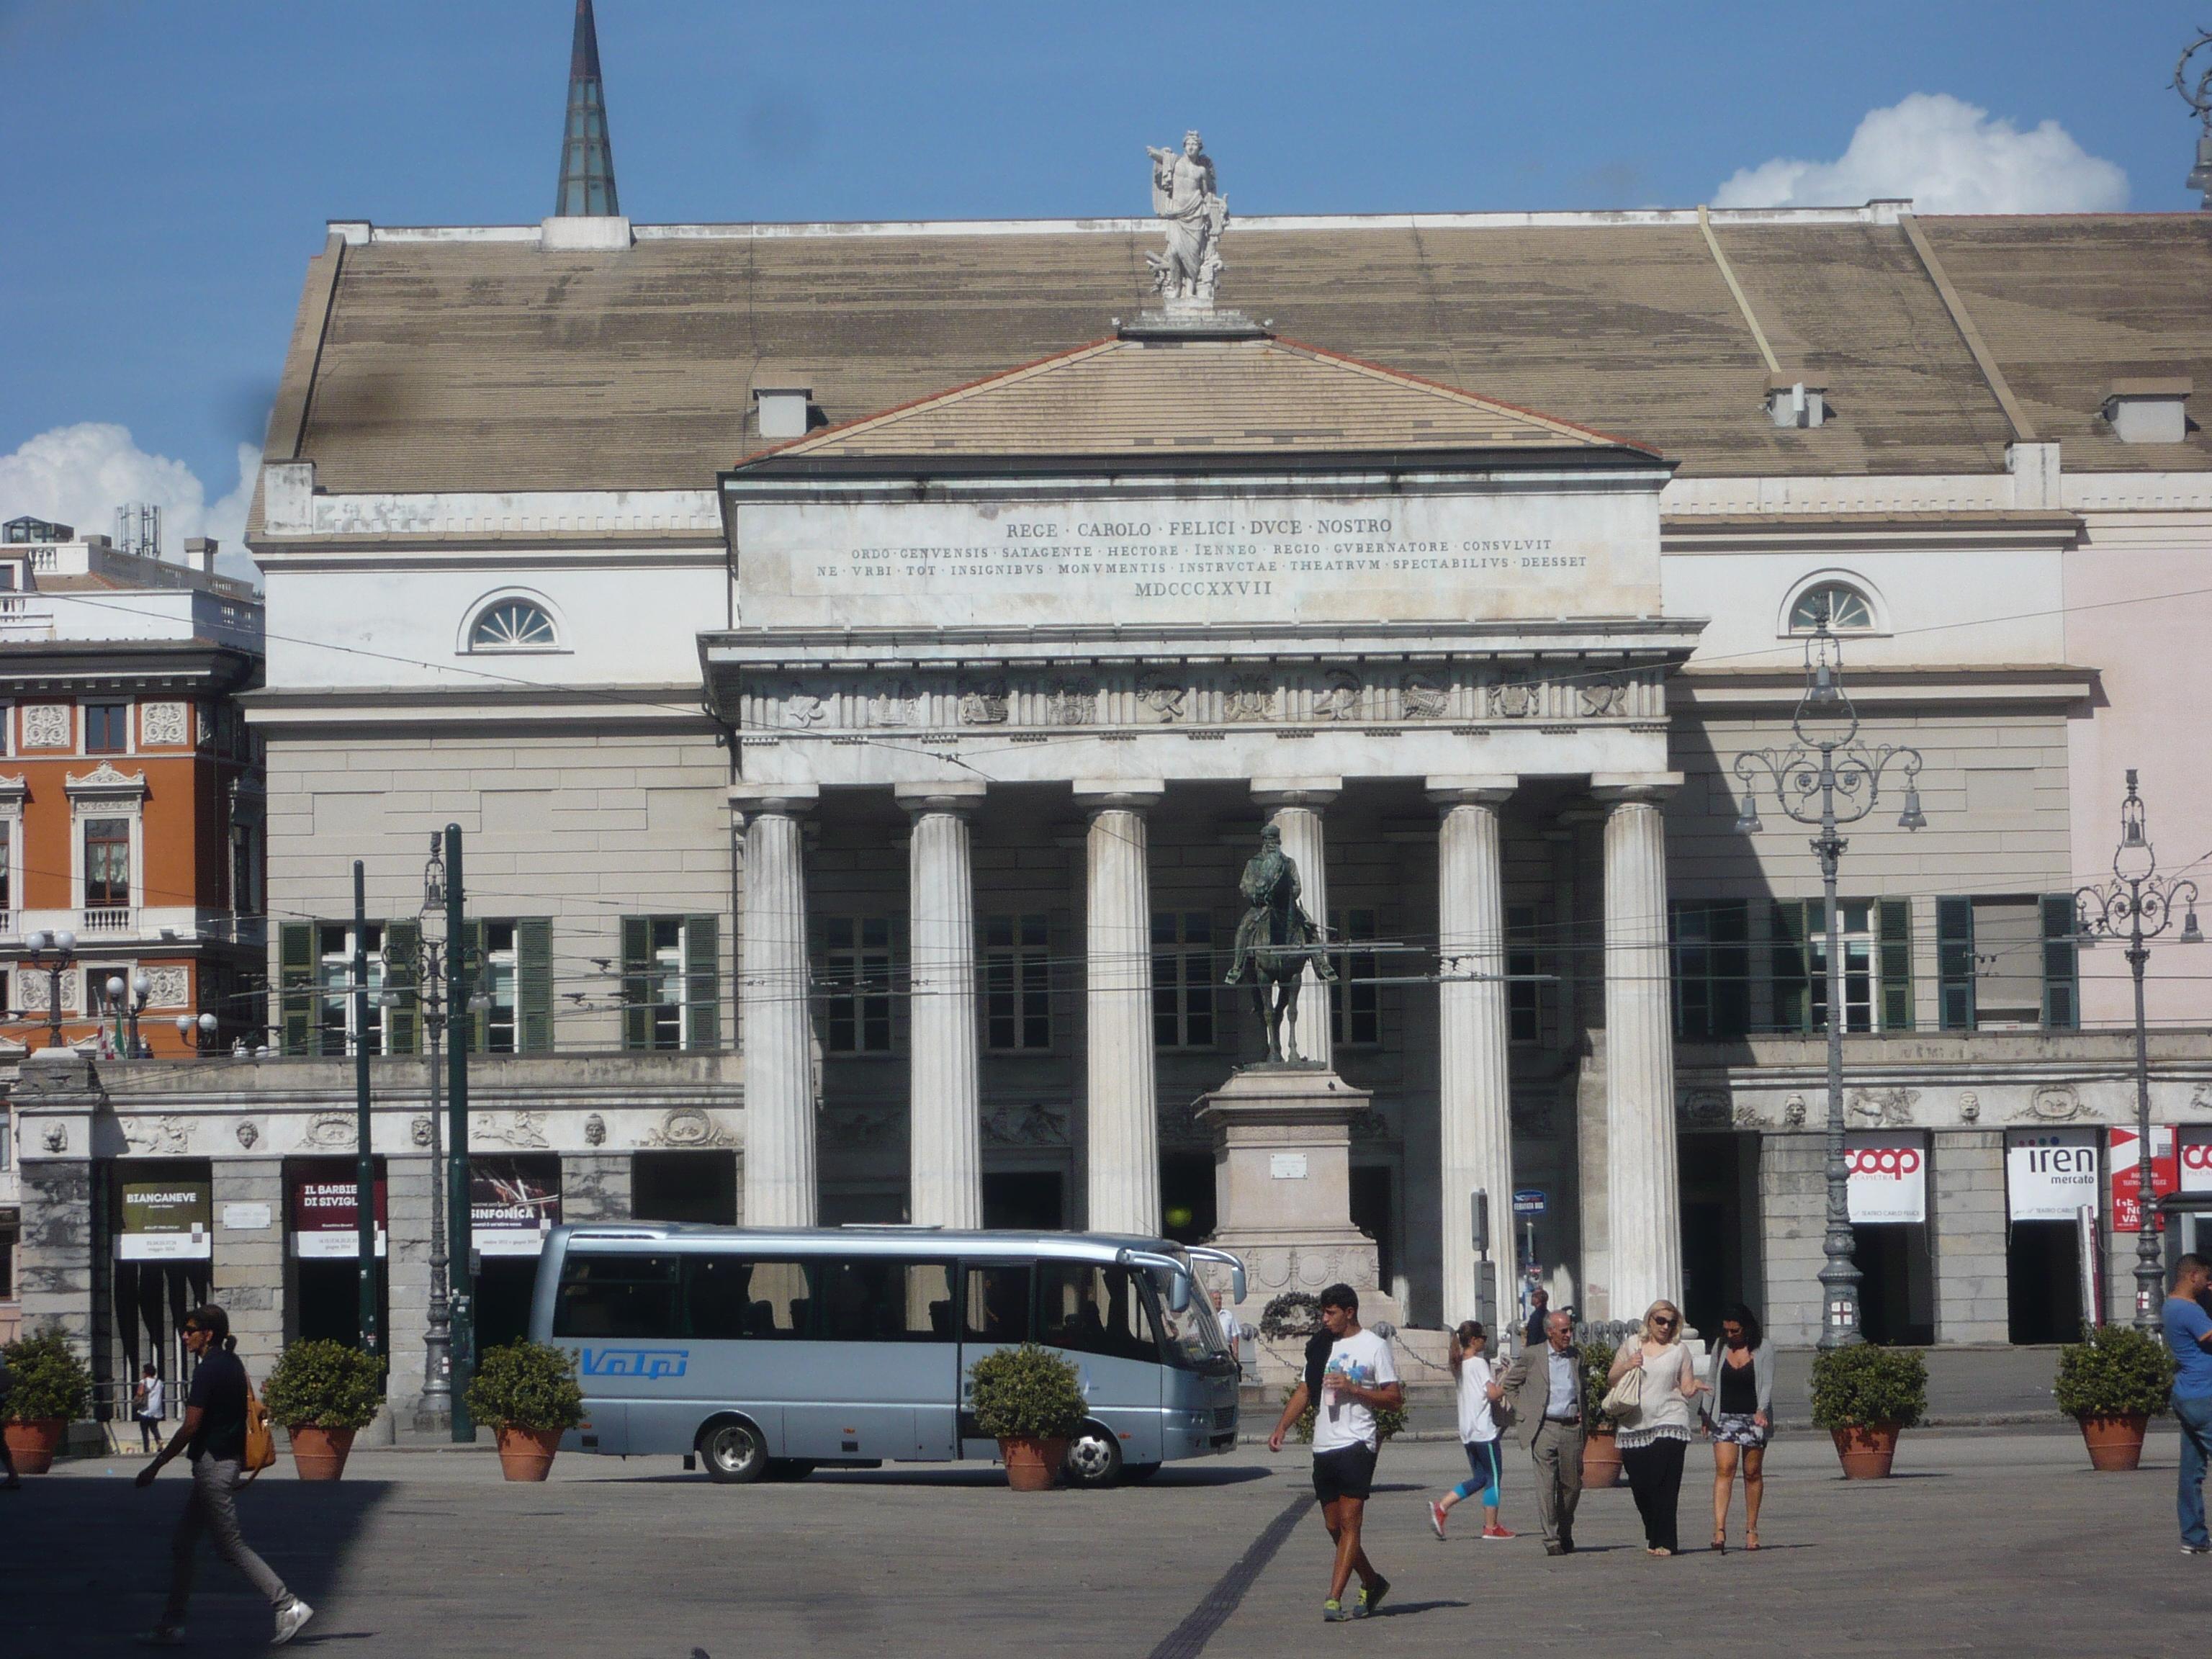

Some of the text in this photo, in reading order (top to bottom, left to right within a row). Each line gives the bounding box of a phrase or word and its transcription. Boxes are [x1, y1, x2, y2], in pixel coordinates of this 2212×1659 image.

[1006, 519, 1392, 538] REGE CAROLO FELICI DVCE NOSTRO
[852, 540, 1552, 559] ORDO GENVENSIS SATAGENTE HECTORE IENNEO REGIO GVBERNATORE CONSVLVIT
[817, 557, 1587, 577] NE VRBI TOT INSIGNIBVS MONVMENTIS INSTRVCTAE THEATRVM SPECTABILIVS DEESSET
[1135, 581, 1272, 597] MDCCCXXVII
[2030, 1148, 2093, 1172] iren
[2051, 1175, 2094, 1184] mercato
[127, 1192, 197, 1203] BIANCANEVE
[305, 1185, 357, 1195] IL BARBIE
[304, 1197, 358, 1206] DI SIVIGL
